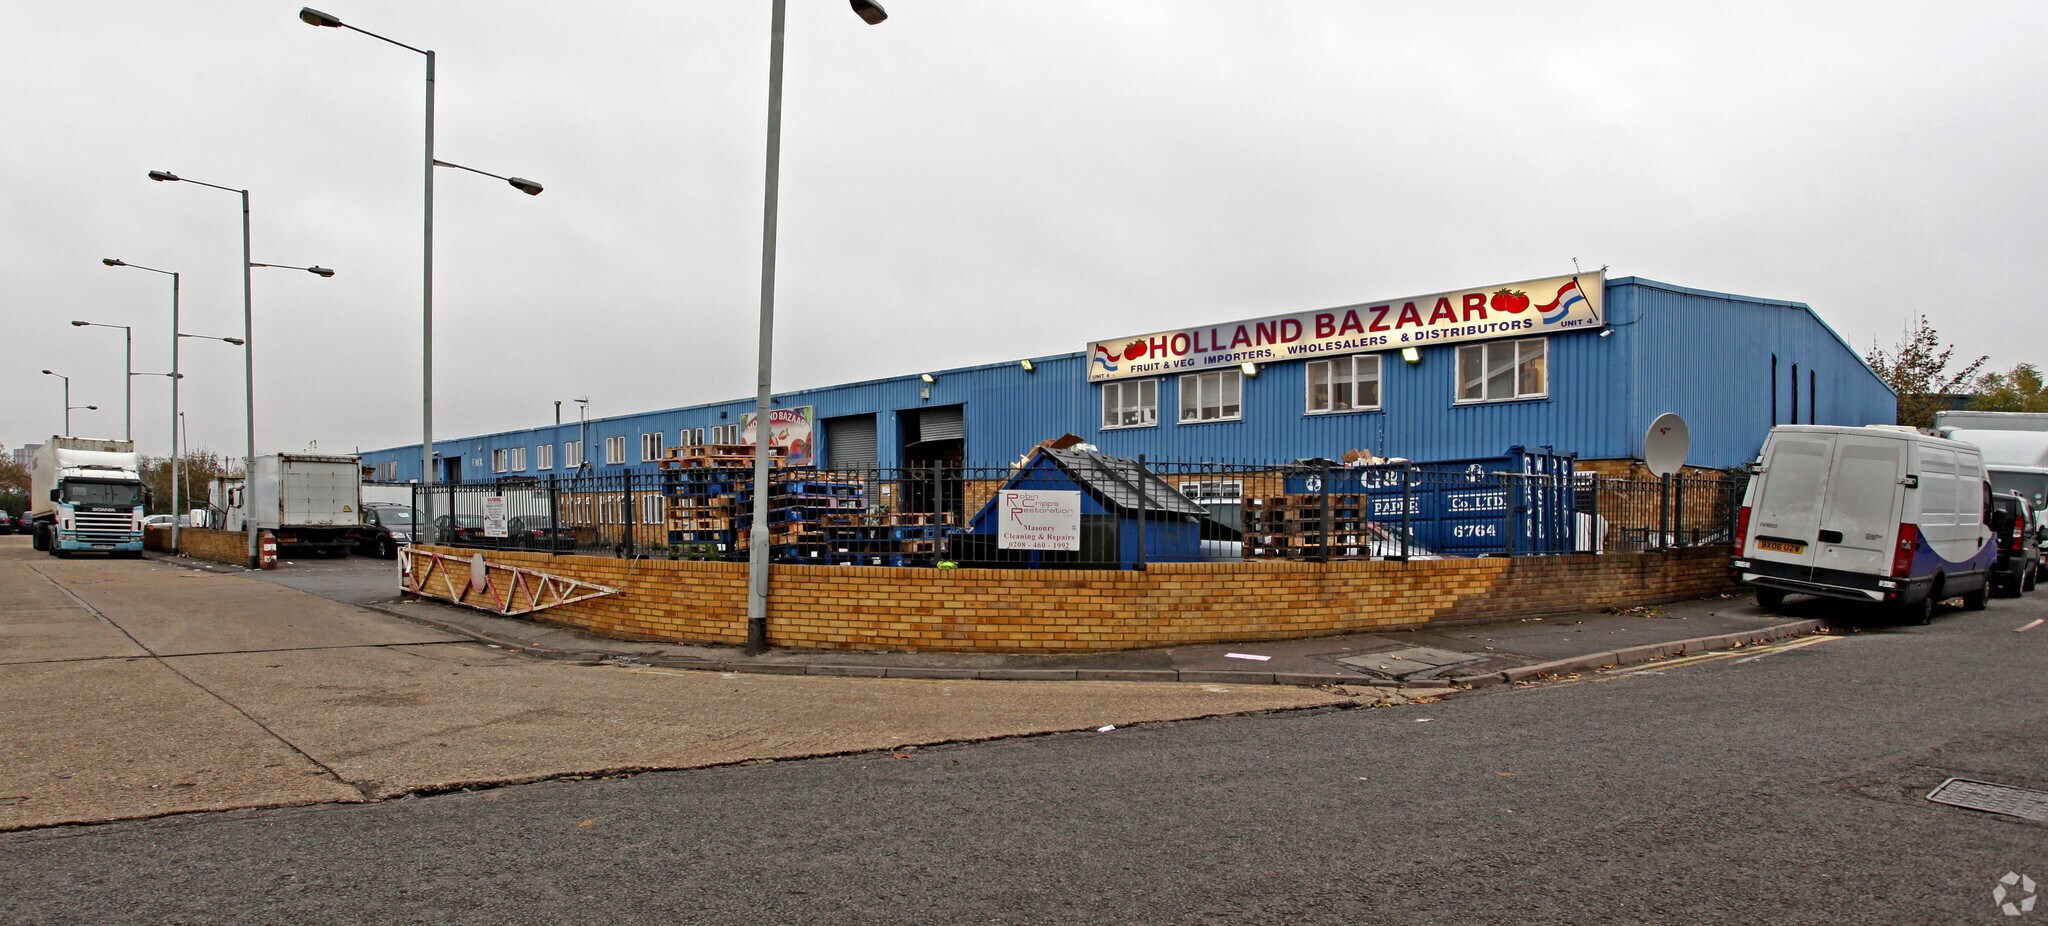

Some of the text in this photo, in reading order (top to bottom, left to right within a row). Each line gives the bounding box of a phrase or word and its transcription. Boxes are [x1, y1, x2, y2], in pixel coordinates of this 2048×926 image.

[1149, 293, 1488, 360] HOLLAND BAZAAR
[1561, 319, 1583, 327] UNIT
[1130, 318, 1533, 373] FRUIT & VEG IMPORTERS, WHOLESALERS & DISTRIBUTORS
[747, 411, 806, 432] HOND BAZAAR
[1006, 492, 1038, 507] Robin
[1022, 498, 1059, 509] Cripps
[1011, 507, 1074, 521] Restoration
[1047, 533, 1075, 541] Repairs
[1454, 524, 1496, 538] 6764
